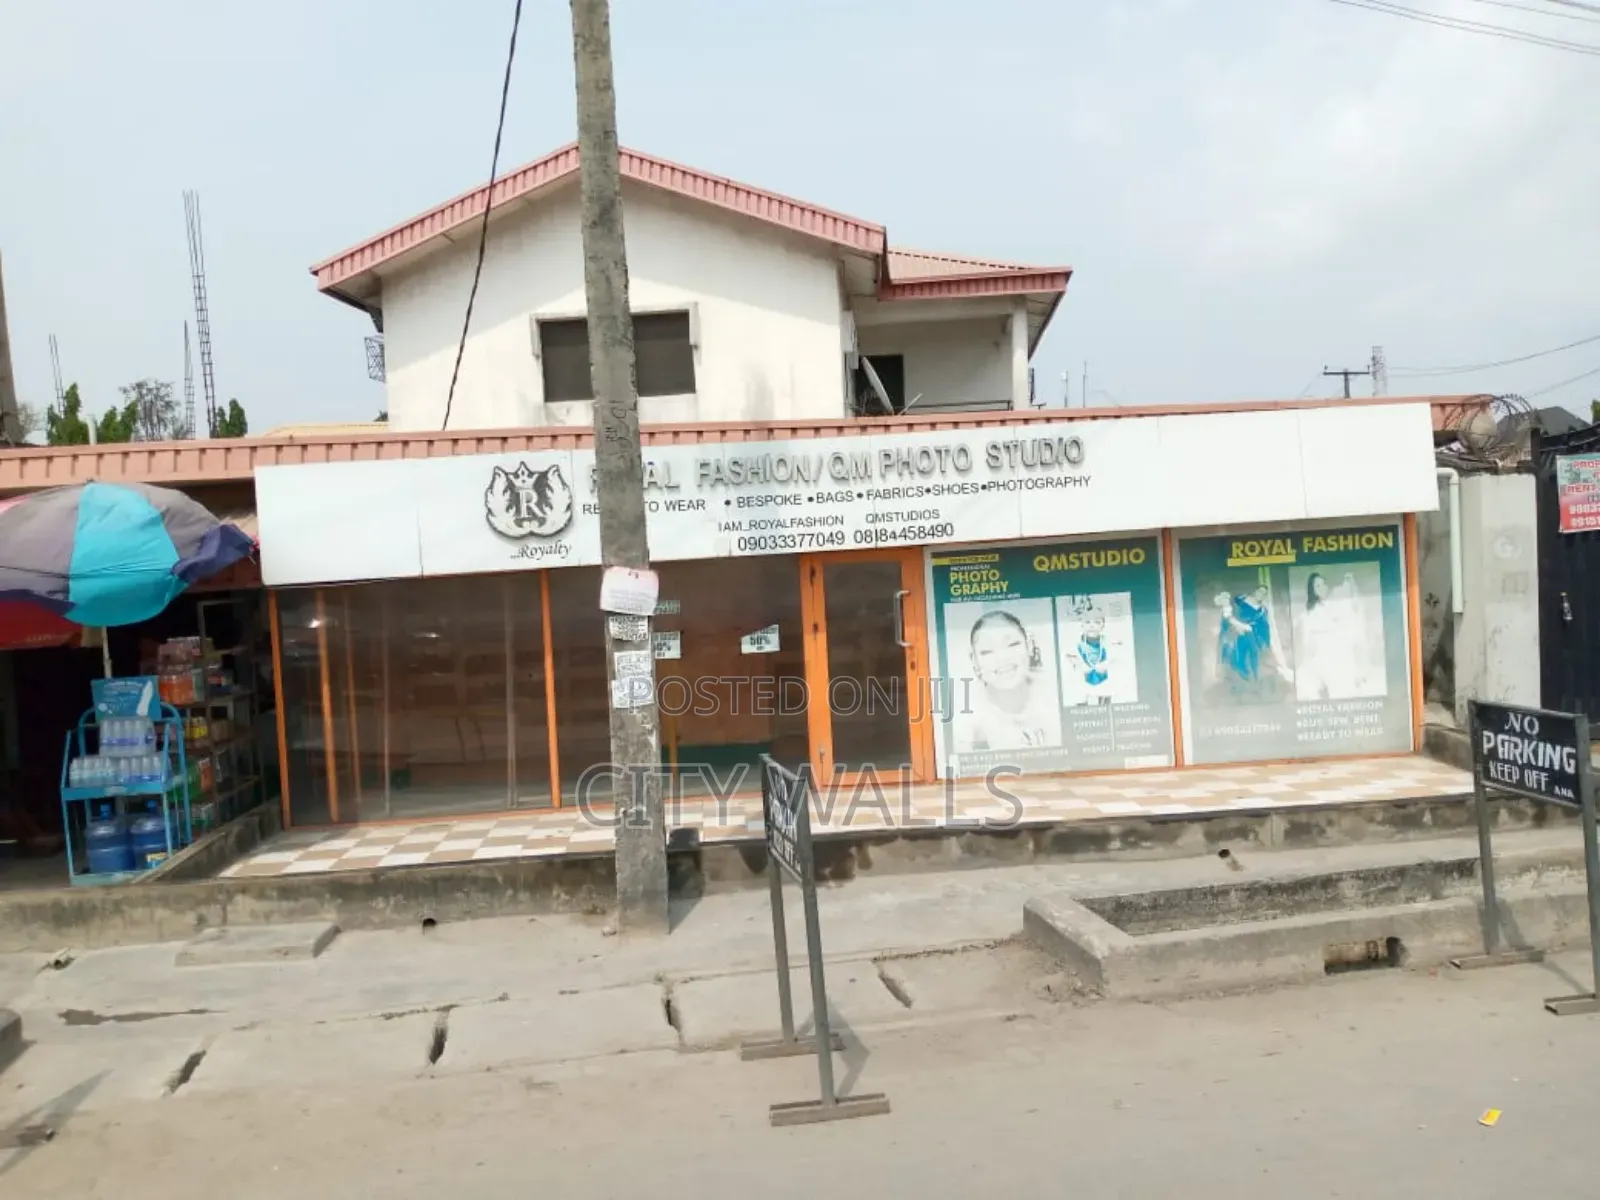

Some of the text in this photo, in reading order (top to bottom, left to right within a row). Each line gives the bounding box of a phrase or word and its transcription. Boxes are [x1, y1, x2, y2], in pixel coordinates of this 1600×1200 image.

[878, 445, 972, 477] PHOTO
[986, 436, 1084, 469] STUDIO
[644, 476, 1091, 513] O WEAR BESPOKE BAGS FABRICS SHOES PHOTOGRAPHY
[866, 509, 940, 524] QMSTUDIOS
[737, 523, 954, 551] 09033377049 08184458490
[1231, 532, 1394, 558] ROYAL FASHION
[1033, 548, 1146, 572] QMSTUDIO
[949, 569, 1000, 584] PHOTO
[950, 580, 1009, 597] GRAPHY
[1504, 711, 1540, 736] NO
[1482, 730, 1577, 775] PARKING
[1489, 760, 1520, 784] KEEP
[1524, 768, 1549, 792] OFF
